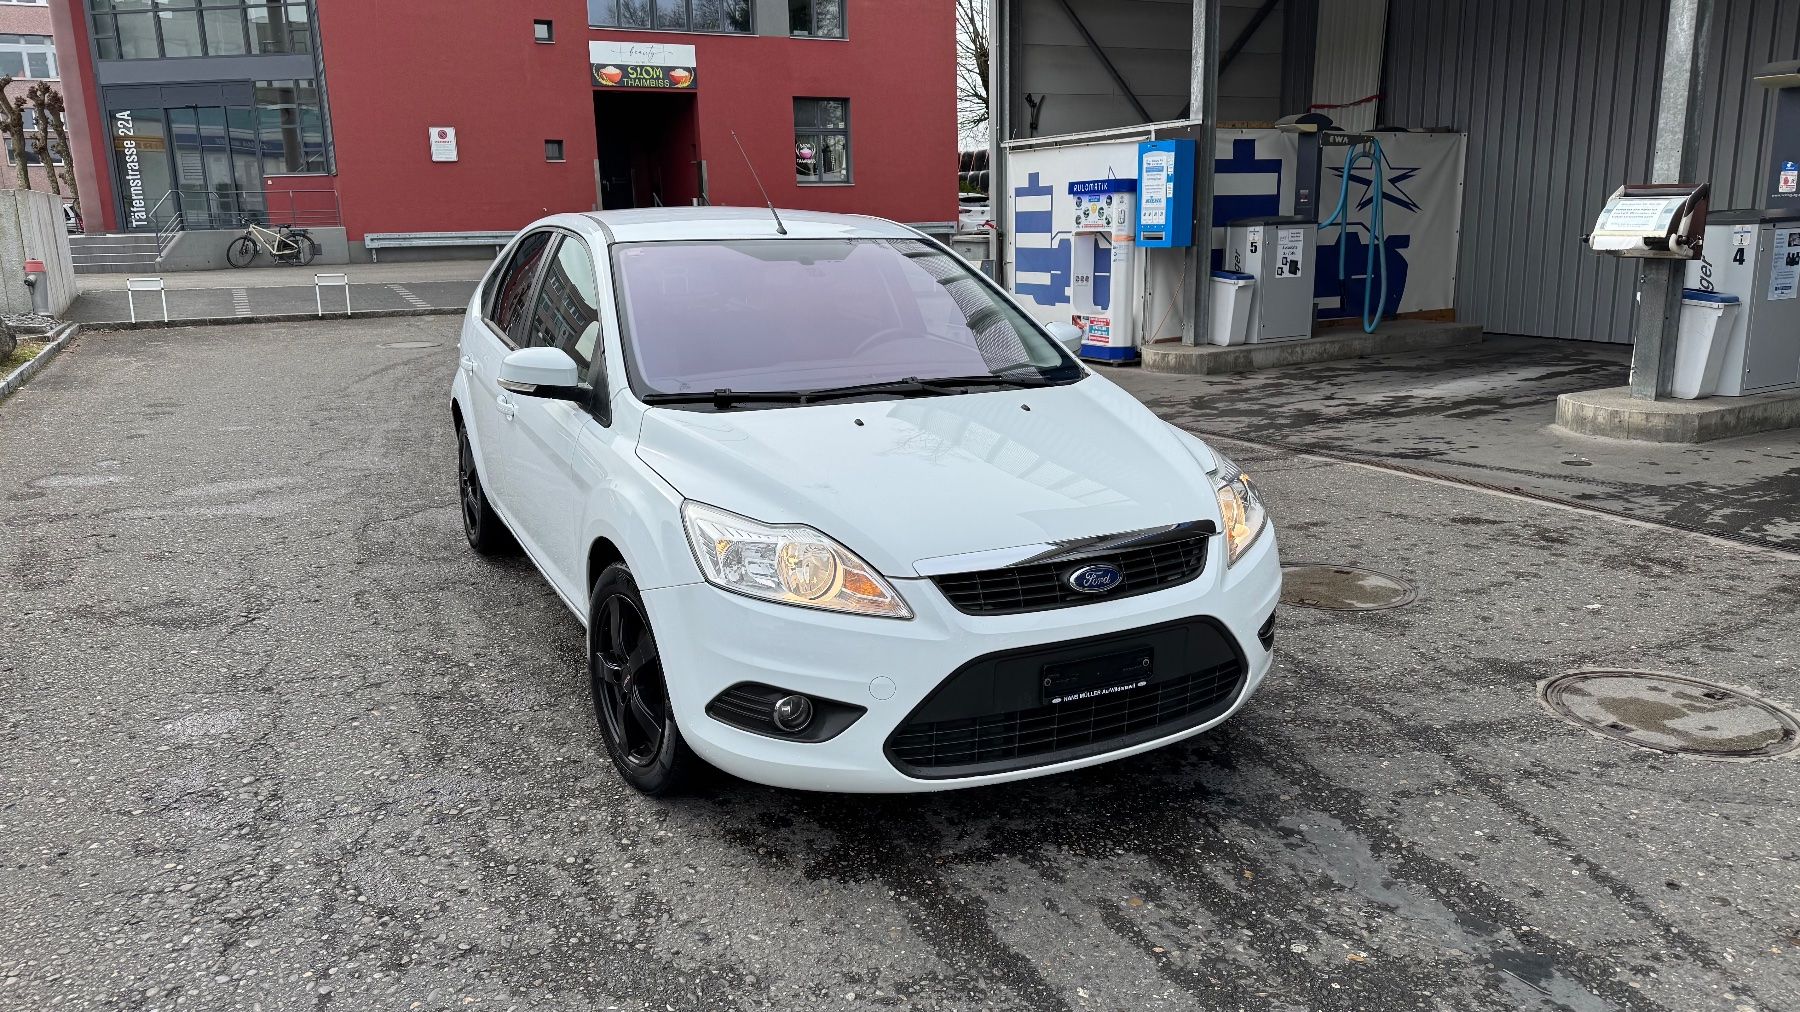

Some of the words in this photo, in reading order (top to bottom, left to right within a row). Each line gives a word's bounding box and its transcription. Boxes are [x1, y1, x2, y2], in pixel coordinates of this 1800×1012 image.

[627, 65, 663, 79] SLOM
[622, 78, 670, 88] THAIMBISS
[115, 110, 135, 137] 22A
[1329, 135, 1349, 144] EWA
[123, 139, 148, 228] Täfernstrasse
[1249, 241, 1258, 254] 5
[1732, 247, 1746, 266] 4
[1698, 254, 1715, 292] ger
[1083, 571, 1112, 587] Ford
